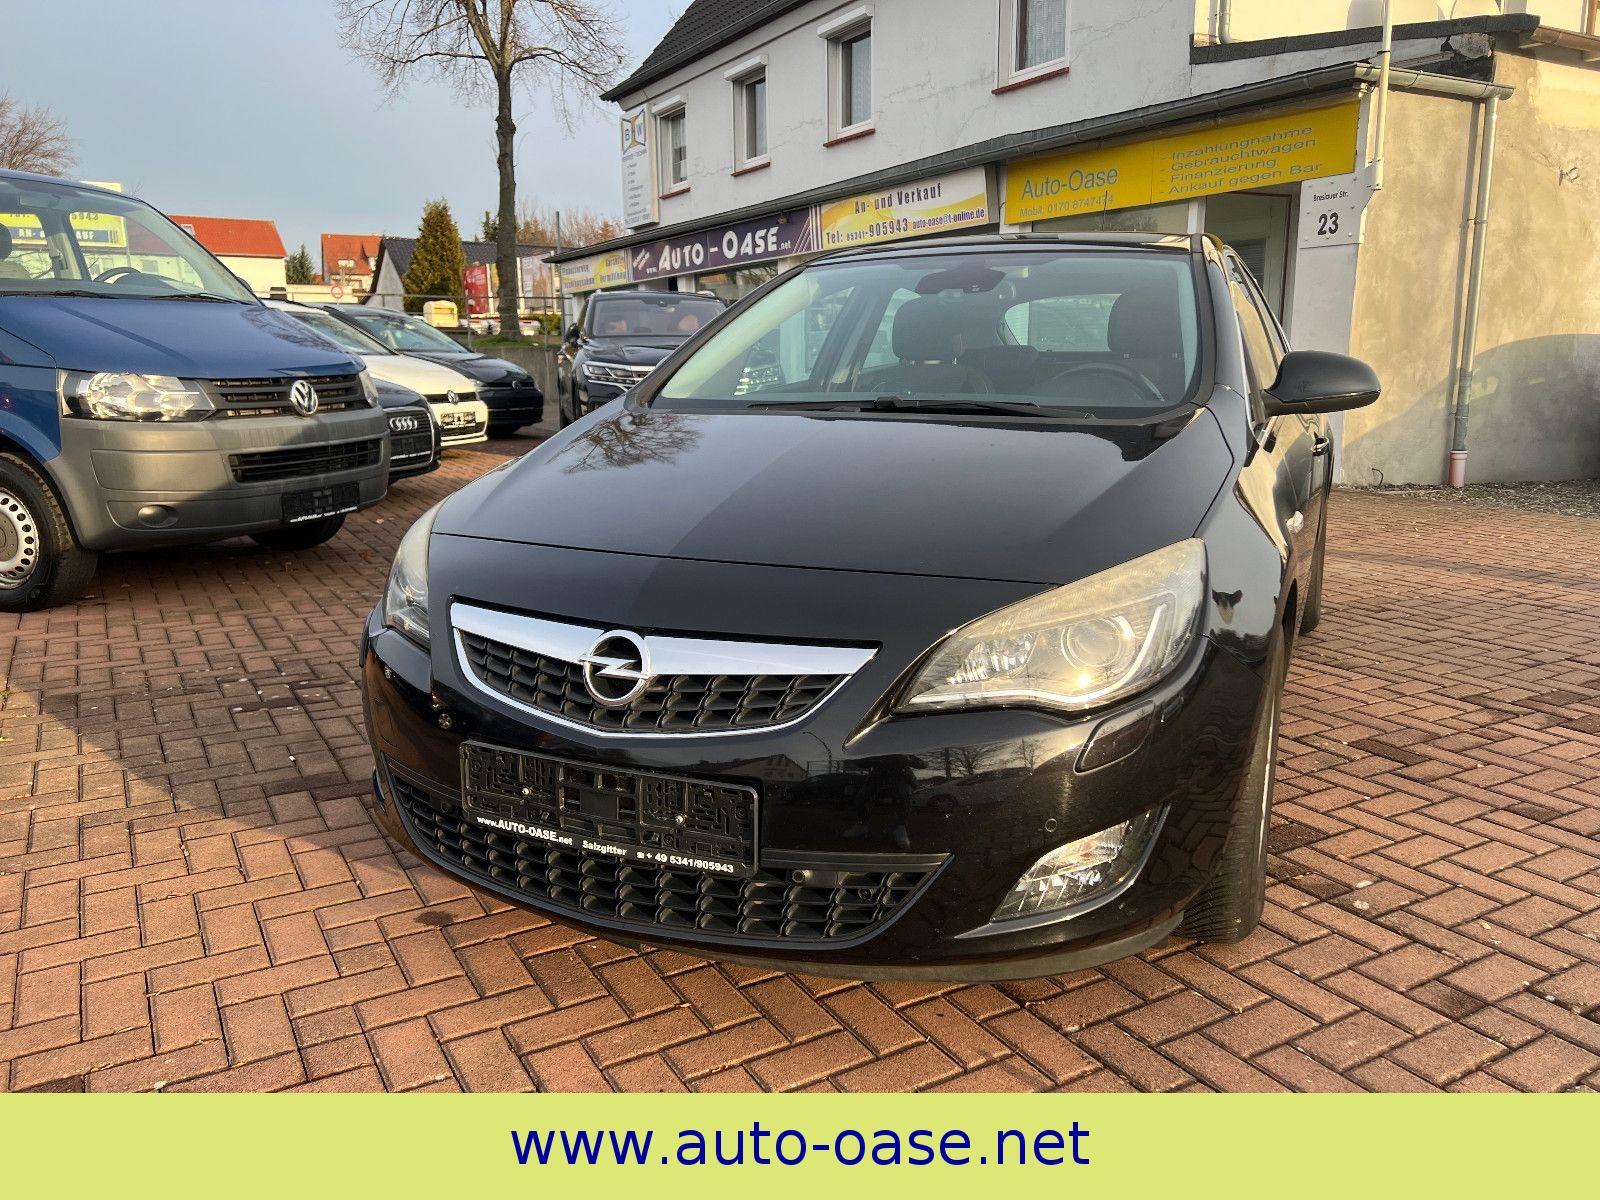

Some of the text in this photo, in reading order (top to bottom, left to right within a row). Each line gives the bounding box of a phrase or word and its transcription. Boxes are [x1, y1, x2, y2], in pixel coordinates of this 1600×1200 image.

[1171, 139, 1317, 171] Gebrauchtwagen
[1172, 127, 1313, 161] Inzahlungnahme
[1168, 163, 1322, 195] Ankauf gegen Bar
[1170, 158, 1277, 183] Finanzierung
[874, 193, 893, 210] und
[897, 183, 942, 206] Verkauf
[1021, 168, 1119, 201] Auto-Oase
[1339, 190, 1349, 198] Str.
[1047, 202, 1070, 212] 0170
[826, 229, 843, 245] Tel:
[1317, 212, 1339, 236] 23
[476, 816, 573, 846] www.AUTO-OASE.net
[582, 840, 628, 856] Salzgitter
[654, 852, 668, 863] 49
[669, 855, 734, 874] 5341/905943
